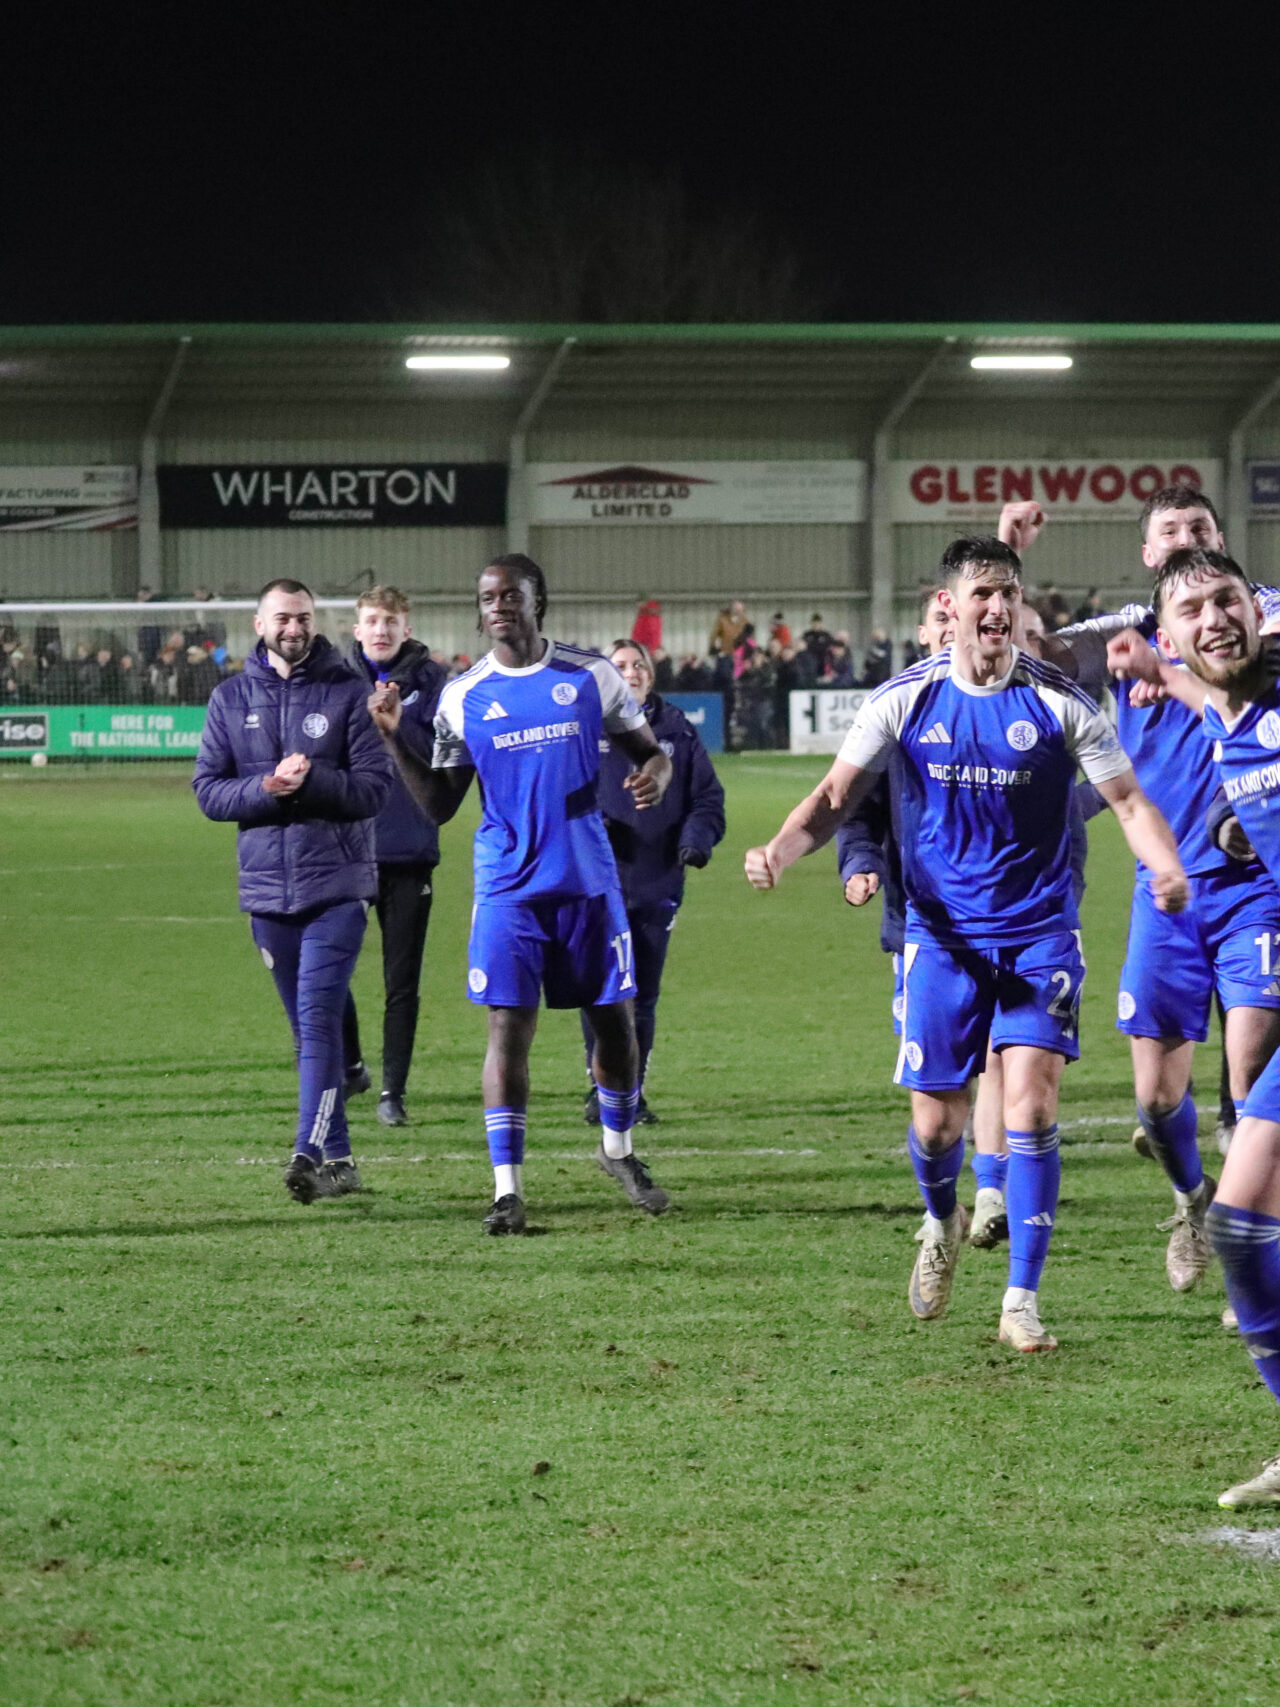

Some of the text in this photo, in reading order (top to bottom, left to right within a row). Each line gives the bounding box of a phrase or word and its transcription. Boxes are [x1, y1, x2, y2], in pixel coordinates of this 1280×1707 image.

[212, 469, 456, 506] WHARTON
[572, 484, 690, 499] ALDERCLAD
[289, 509, 374, 520] CONSTRUCTION
[591, 503, 672, 517] LIMITED
[111, 715, 174, 730] HERE FOR
[70, 732, 95, 747] THE
[98, 732, 161, 747] NATIONAL
[523, 726, 546, 744] AND
[545, 721, 580, 739] COVER
[611, 931, 632, 973] 17
[1047, 970, 1071, 1018] 2
